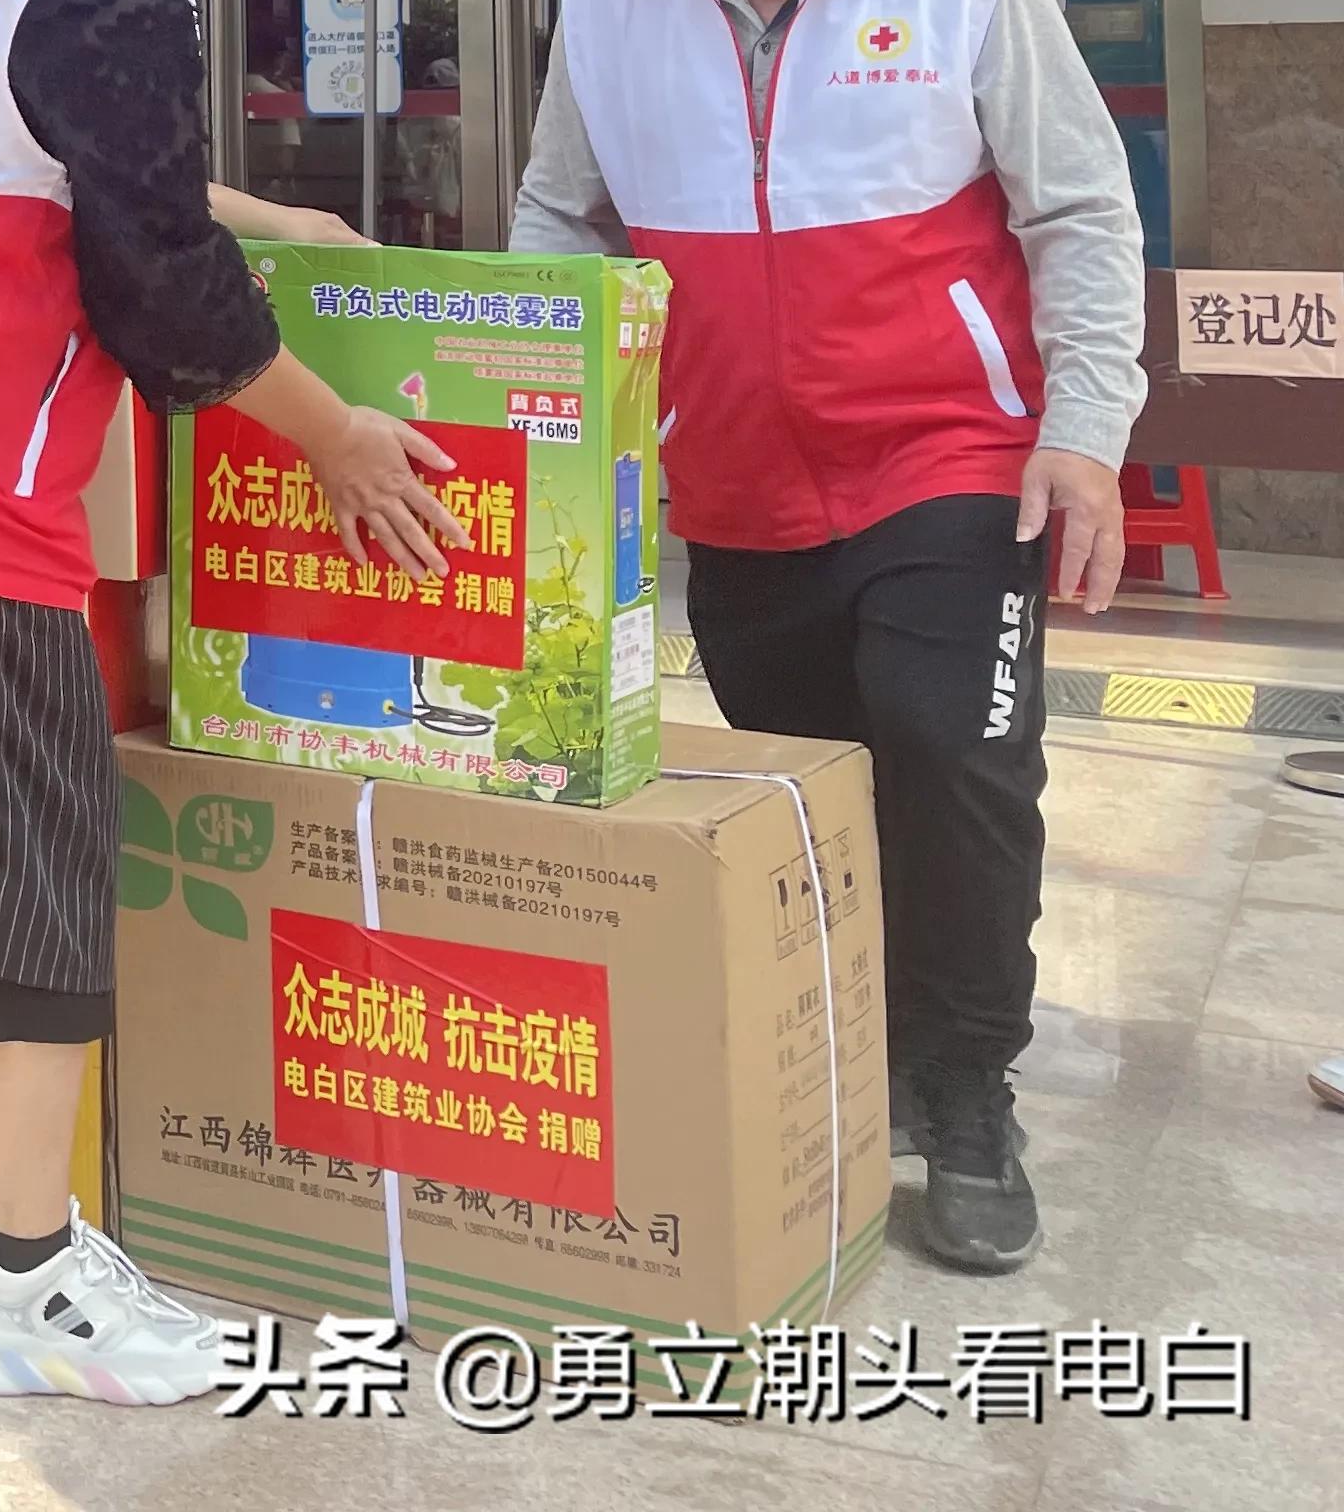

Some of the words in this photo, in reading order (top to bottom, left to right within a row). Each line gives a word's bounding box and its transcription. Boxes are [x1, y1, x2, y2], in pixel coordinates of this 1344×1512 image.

[313, 284, 584, 331] 背负式电动喷雾器
[1188, 292, 1339, 348] 登记处
[510, 417, 579, 443] XF-16M9
[511, 394, 578, 417] 背负式
[452, 571, 514, 615] 捐赠
[984, 591, 1025, 739] WFAR
[201, 715, 569, 791] 台州市协丰机械有限公司
[283, 962, 430, 1062] 众志成城
[444, 991, 599, 1099] 抗击疫情
[283, 1056, 528, 1145] 电白区建筑业协会
[538, 1107, 602, 1162] 捐赠
